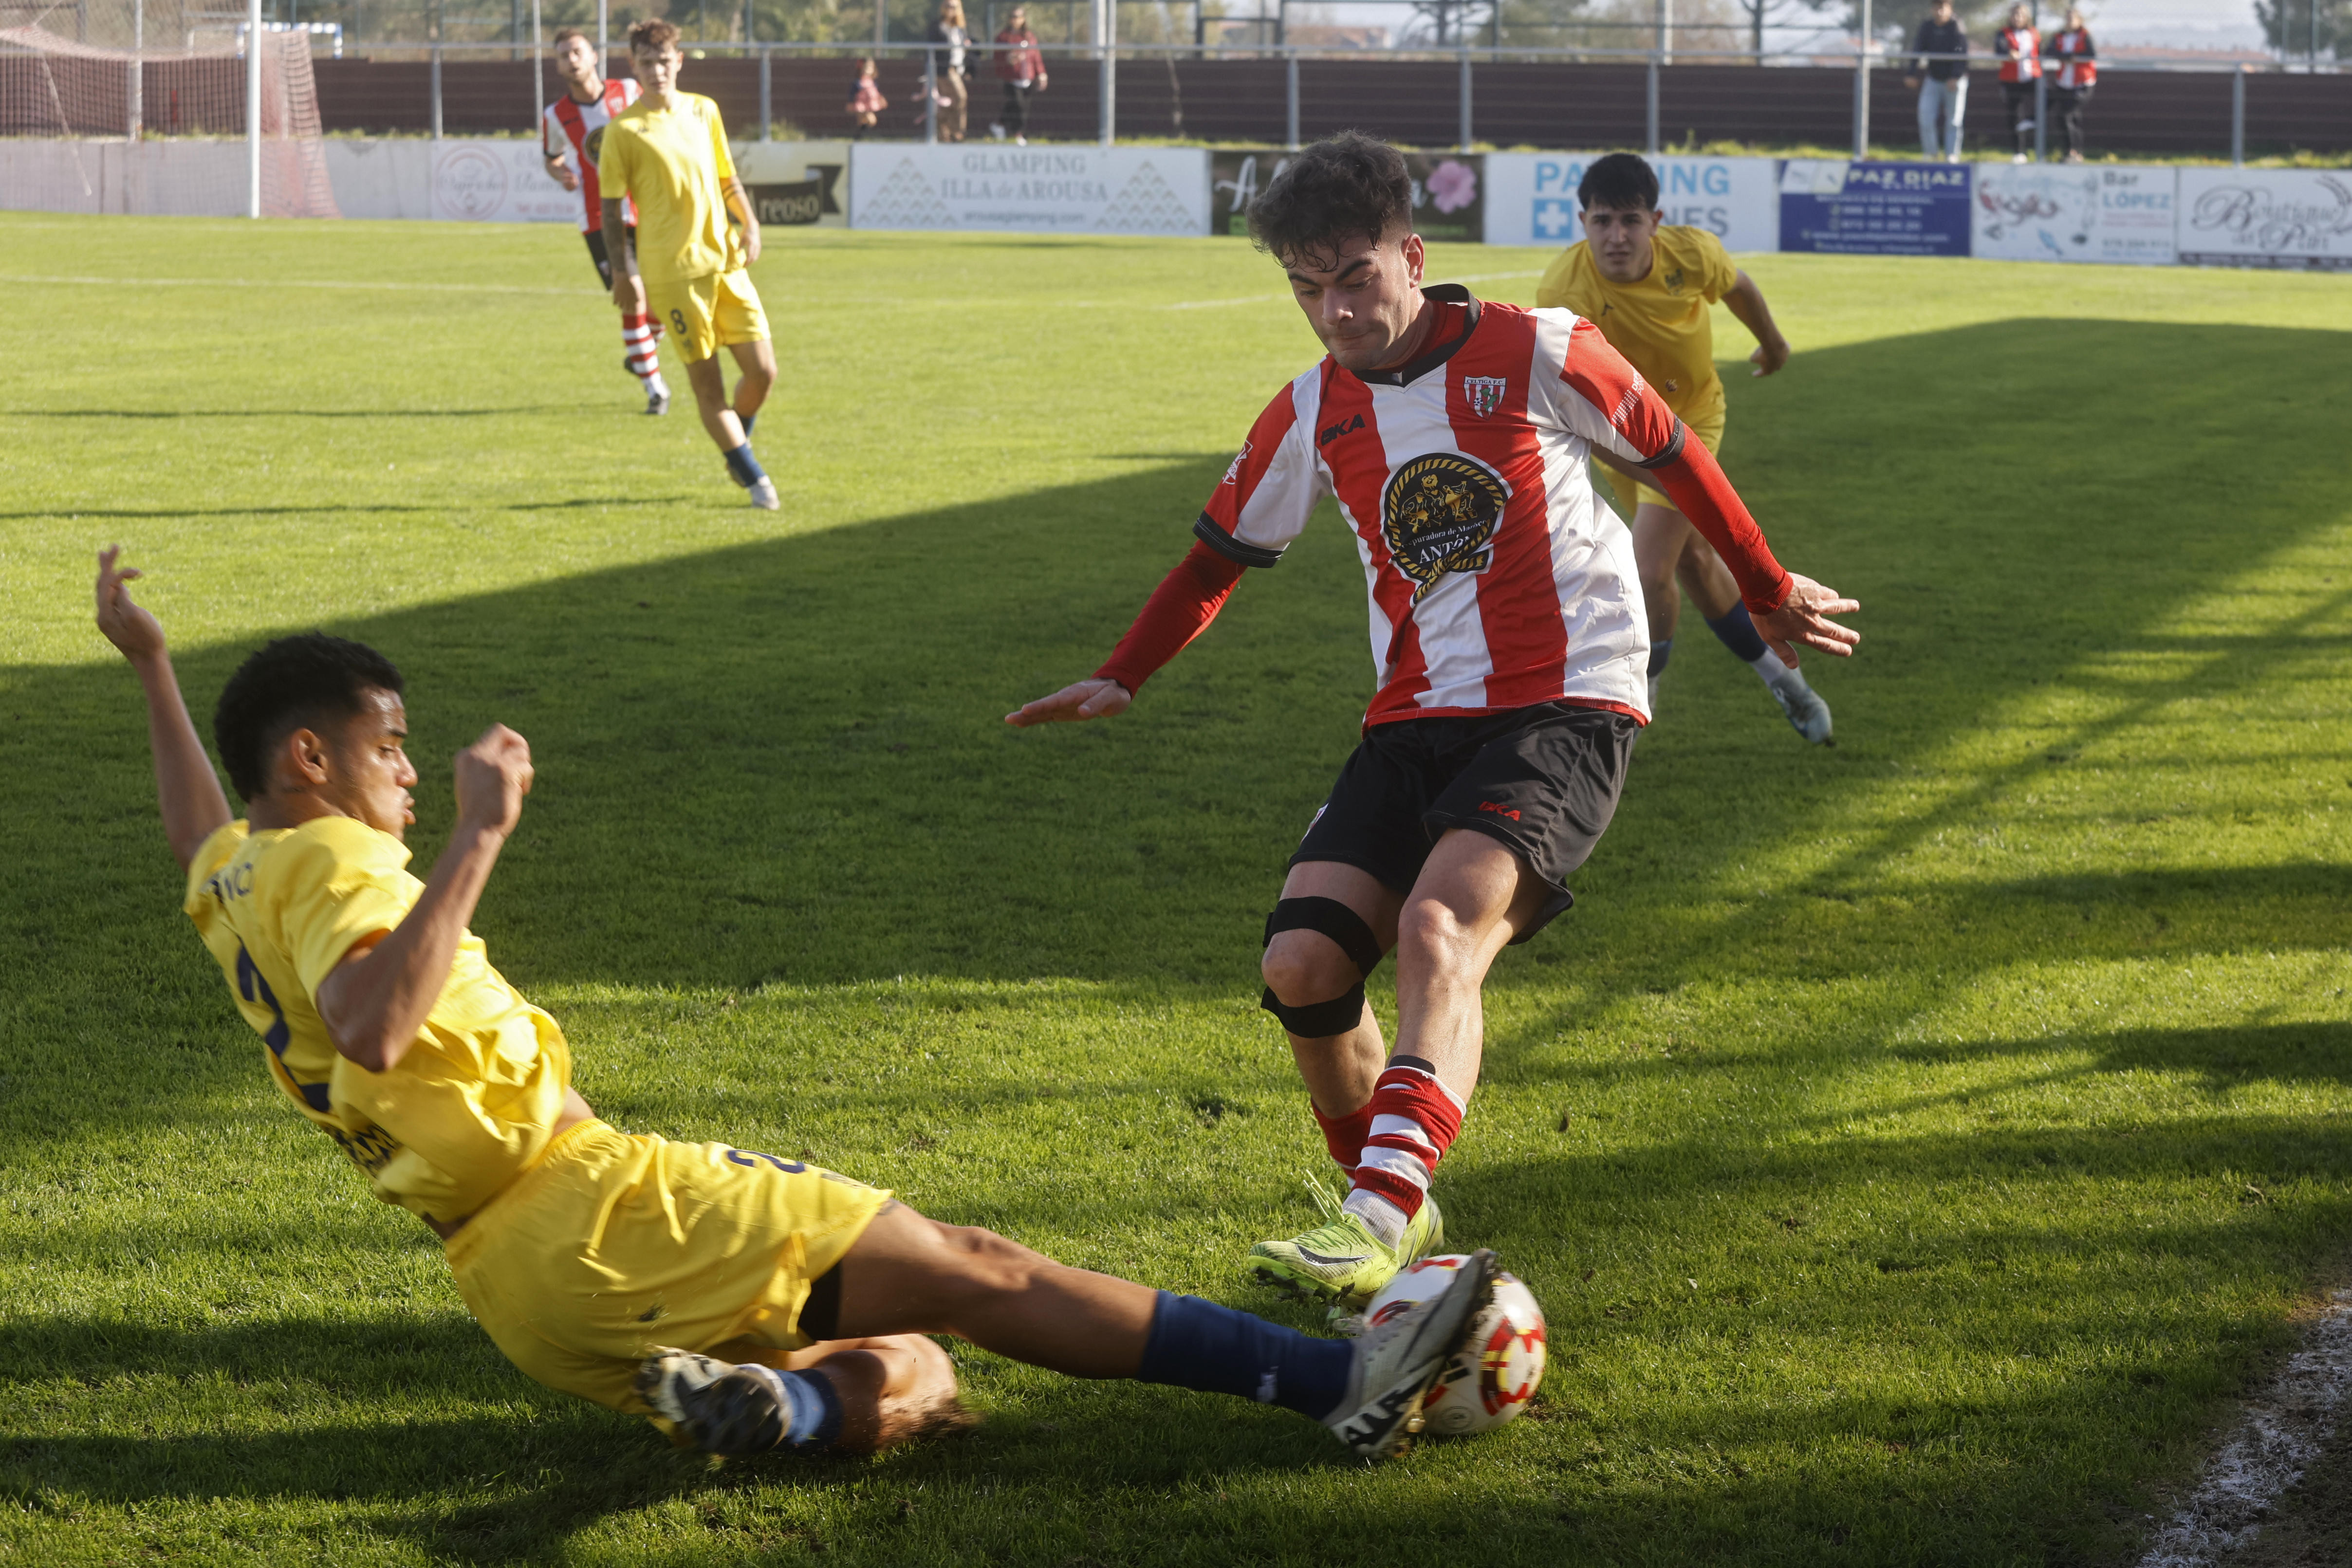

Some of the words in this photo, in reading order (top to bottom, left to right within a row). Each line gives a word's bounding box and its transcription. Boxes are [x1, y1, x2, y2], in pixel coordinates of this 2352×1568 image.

[962, 152, 1086, 175] GLAMPING
[941, 178, 992, 200] ILLA
[996, 180, 1014, 199] de
[1017, 180, 1109, 202] AROUSA
[1535, 162, 1730, 195] PAING
[2103, 171, 2139, 186] Bar
[670, 308, 687, 334] 8
[1447, 528, 1457, 536] de
[727, 1148, 806, 1175] 2
